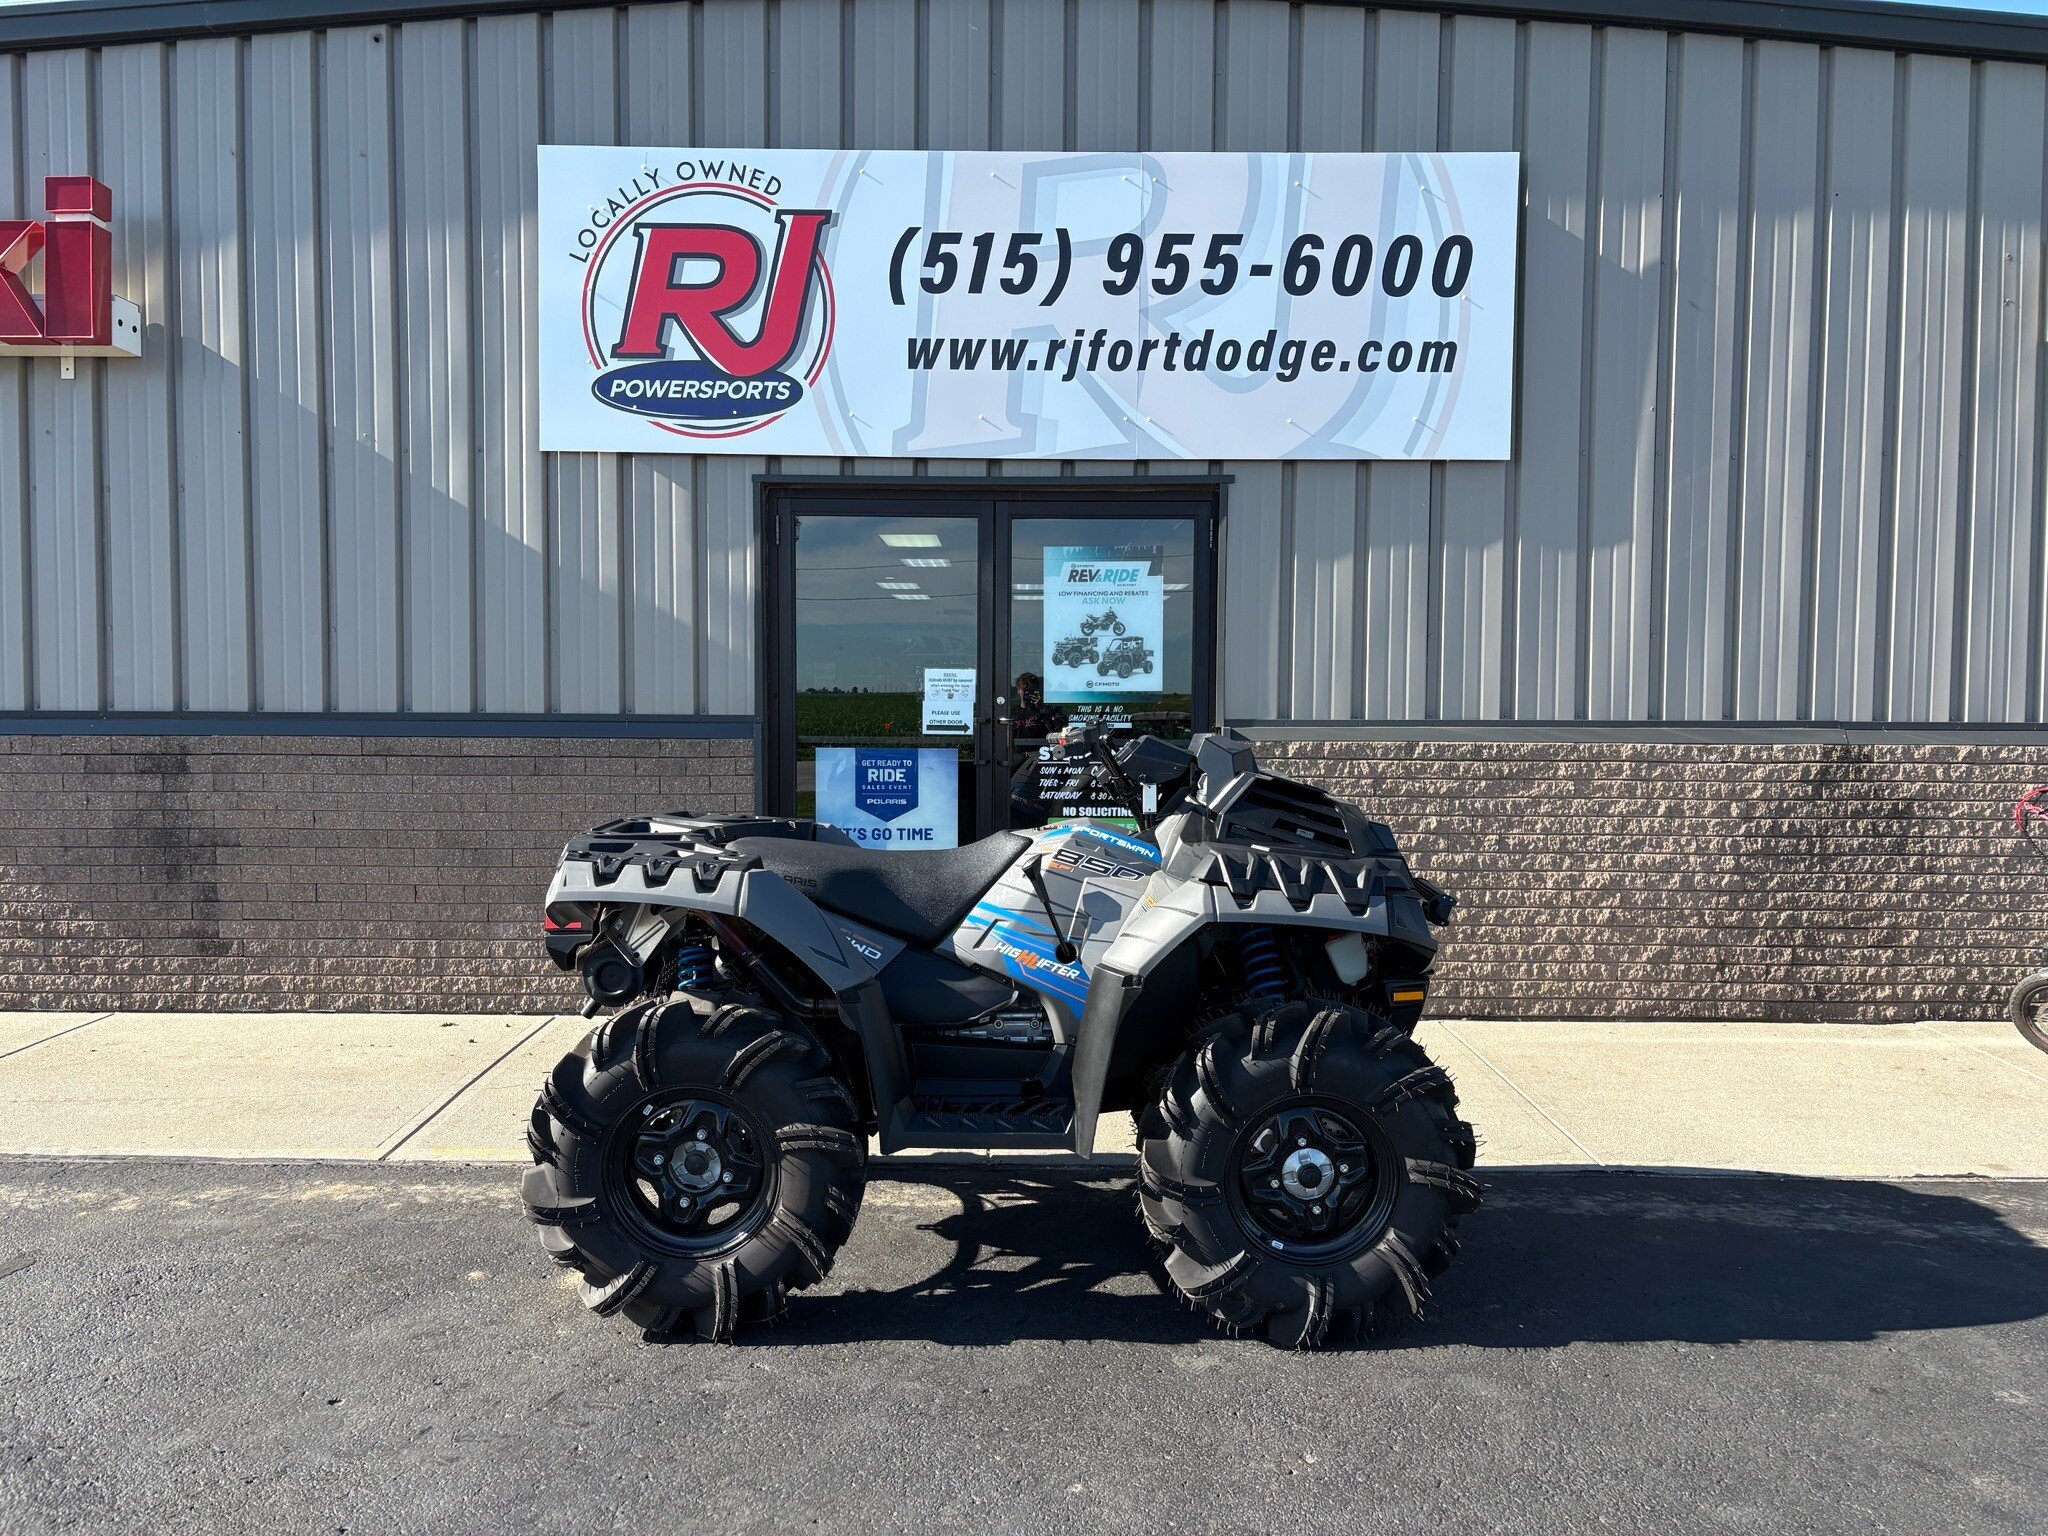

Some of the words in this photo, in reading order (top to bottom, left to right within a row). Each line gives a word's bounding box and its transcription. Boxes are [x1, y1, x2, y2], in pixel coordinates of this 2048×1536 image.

[569, 168, 662, 264] LOCALLY
[676, 159, 783, 196] OWNED
[888, 226, 1072, 306] (515)
[1102, 232, 1474, 299] 955-6000
[609, 209, 837, 378] RJ
[906, 328, 1459, 383] www.rjfortdodge.com
[609, 378, 791, 401] POWERSPORTS
[1067, 569, 1101, 582] REV
[1103, 568, 1140, 586] RIDE
[1081, 597, 1100, 605] ASK
[1101, 597, 1126, 605] NOW
[1077, 705, 1092, 713] THIS
[1094, 705, 1102, 713] IS
[1104, 705, 1111, 713] A
[1113, 705, 1124, 713] NO
[1101, 714, 1133, 722] FACILITY
[861, 759, 876, 767] GET
[877, 759, 902, 767] READY
[902, 759, 913, 767] TO
[867, 768, 907, 783] RIDE
[1039, 766, 1058, 775] SUN
[1063, 766, 1085, 775] MON
[1039, 778, 1059, 787] TUES
[1065, 778, 1080, 787] FRI
[1039, 791, 1083, 800] SATURDAY
[1062, 806, 1077, 817] NO
[840, 827, 867, 841] T'S
[871, 827, 893, 841] GO
[896, 827, 934, 841] TIME
[1071, 824, 1155, 859] SPORTSMAN
[1051, 848, 1147, 882] 850
